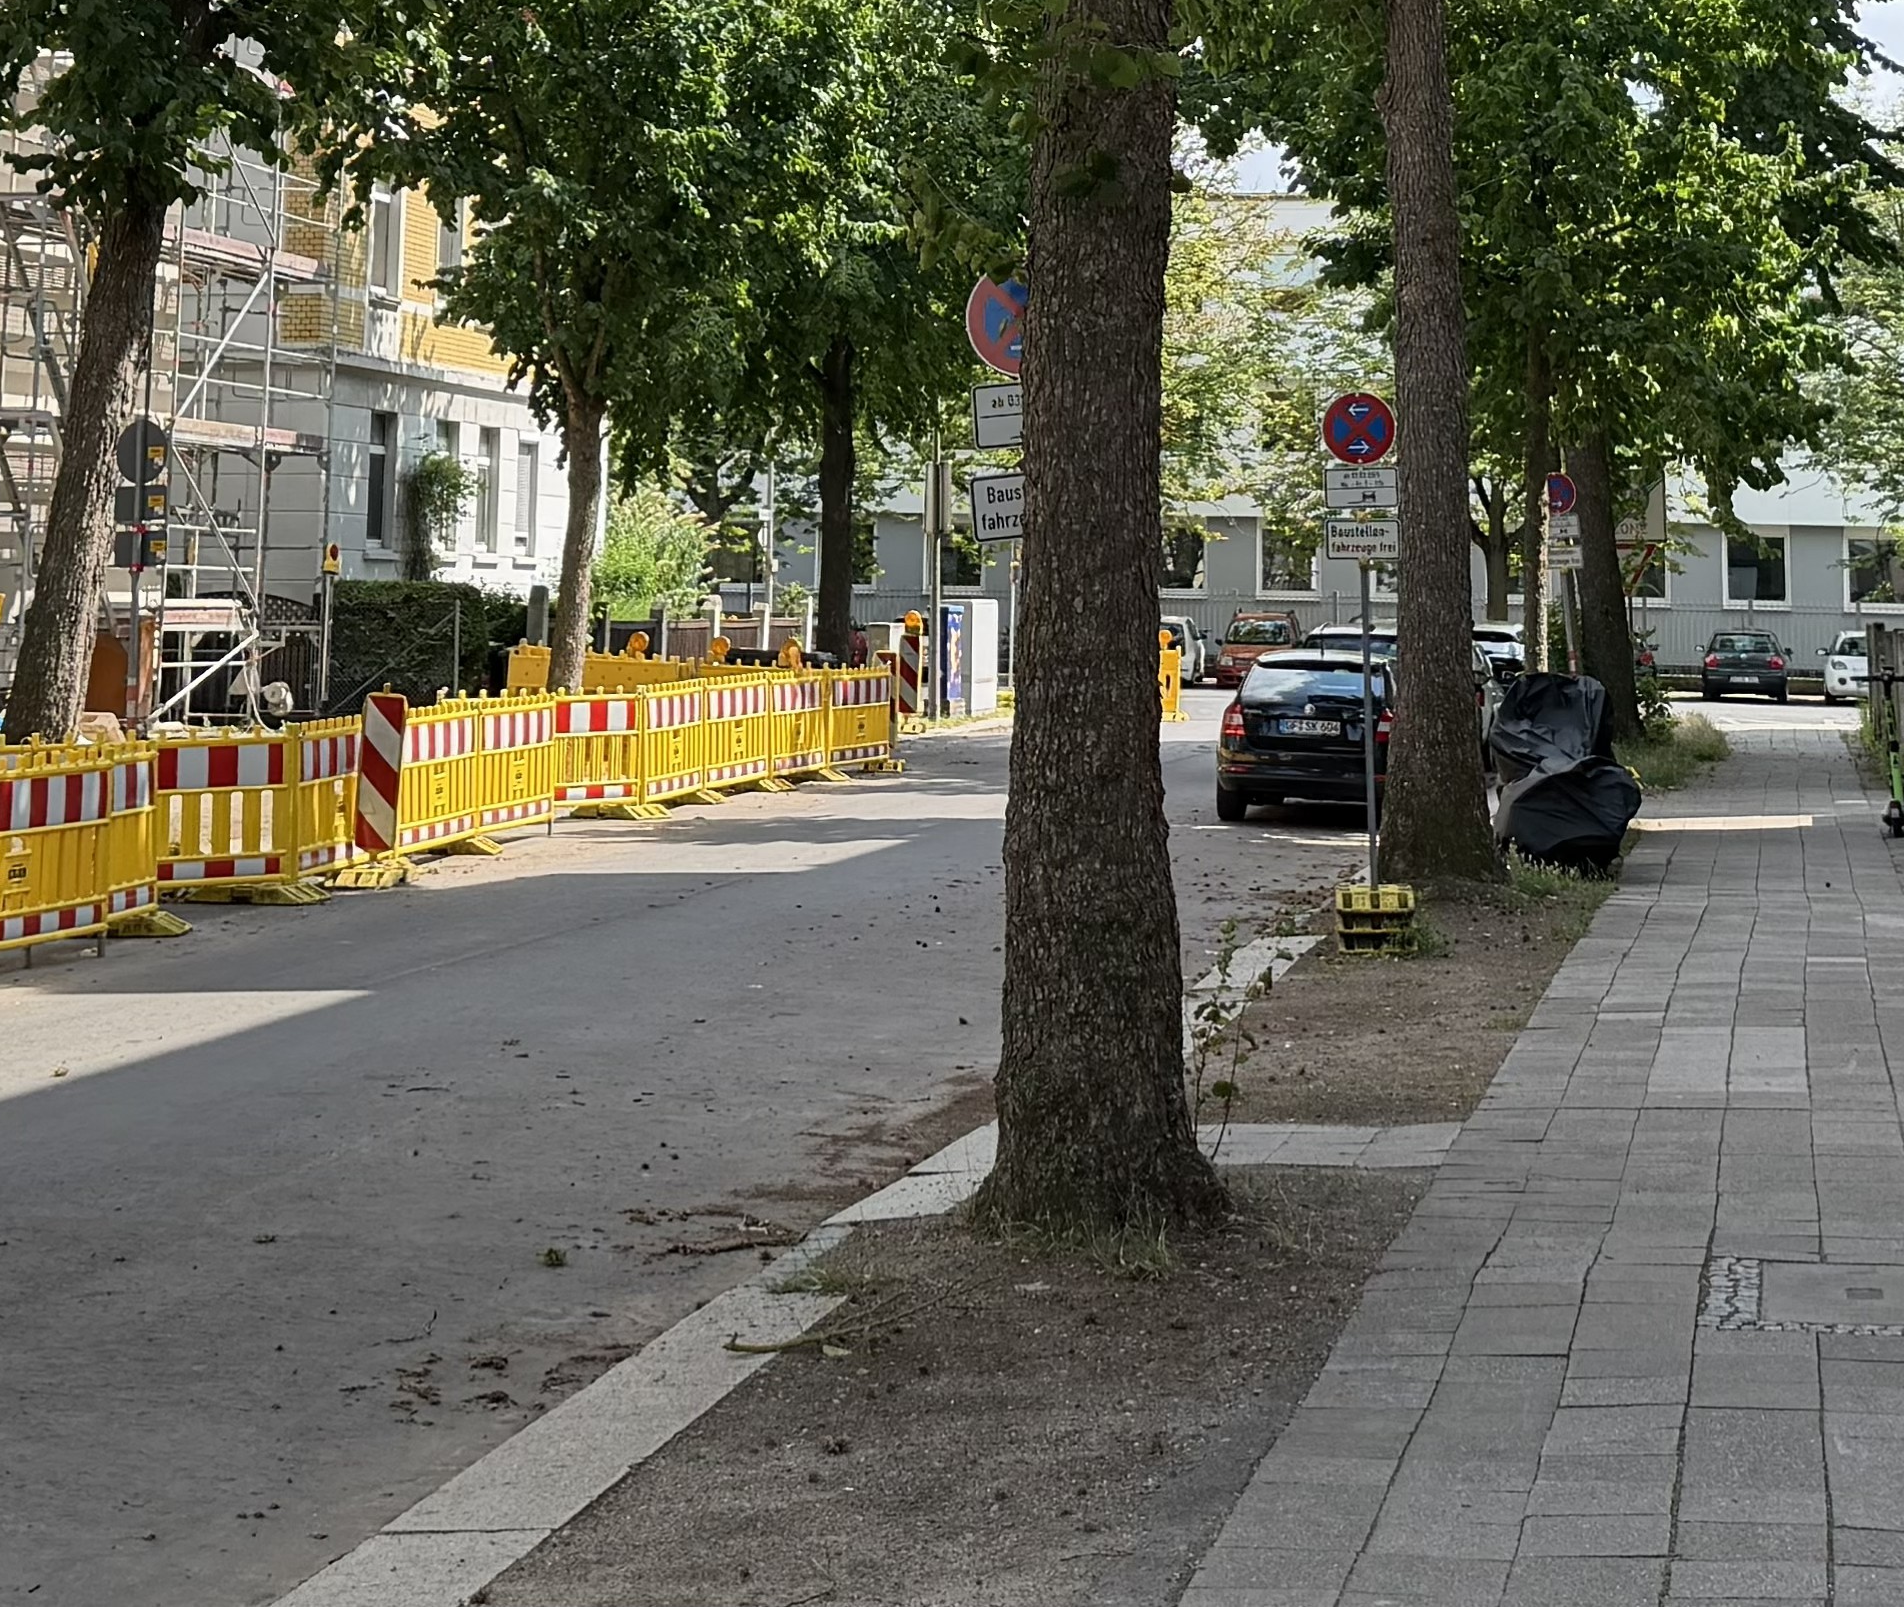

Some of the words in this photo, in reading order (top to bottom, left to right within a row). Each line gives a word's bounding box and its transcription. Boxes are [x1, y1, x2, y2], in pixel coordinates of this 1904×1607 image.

[986, 484, 1023, 504] Baus
[981, 512, 1025, 532] fahrze
[1331, 541, 1376, 556] fahrzeuge
[1379, 541, 1397, 553] frei
